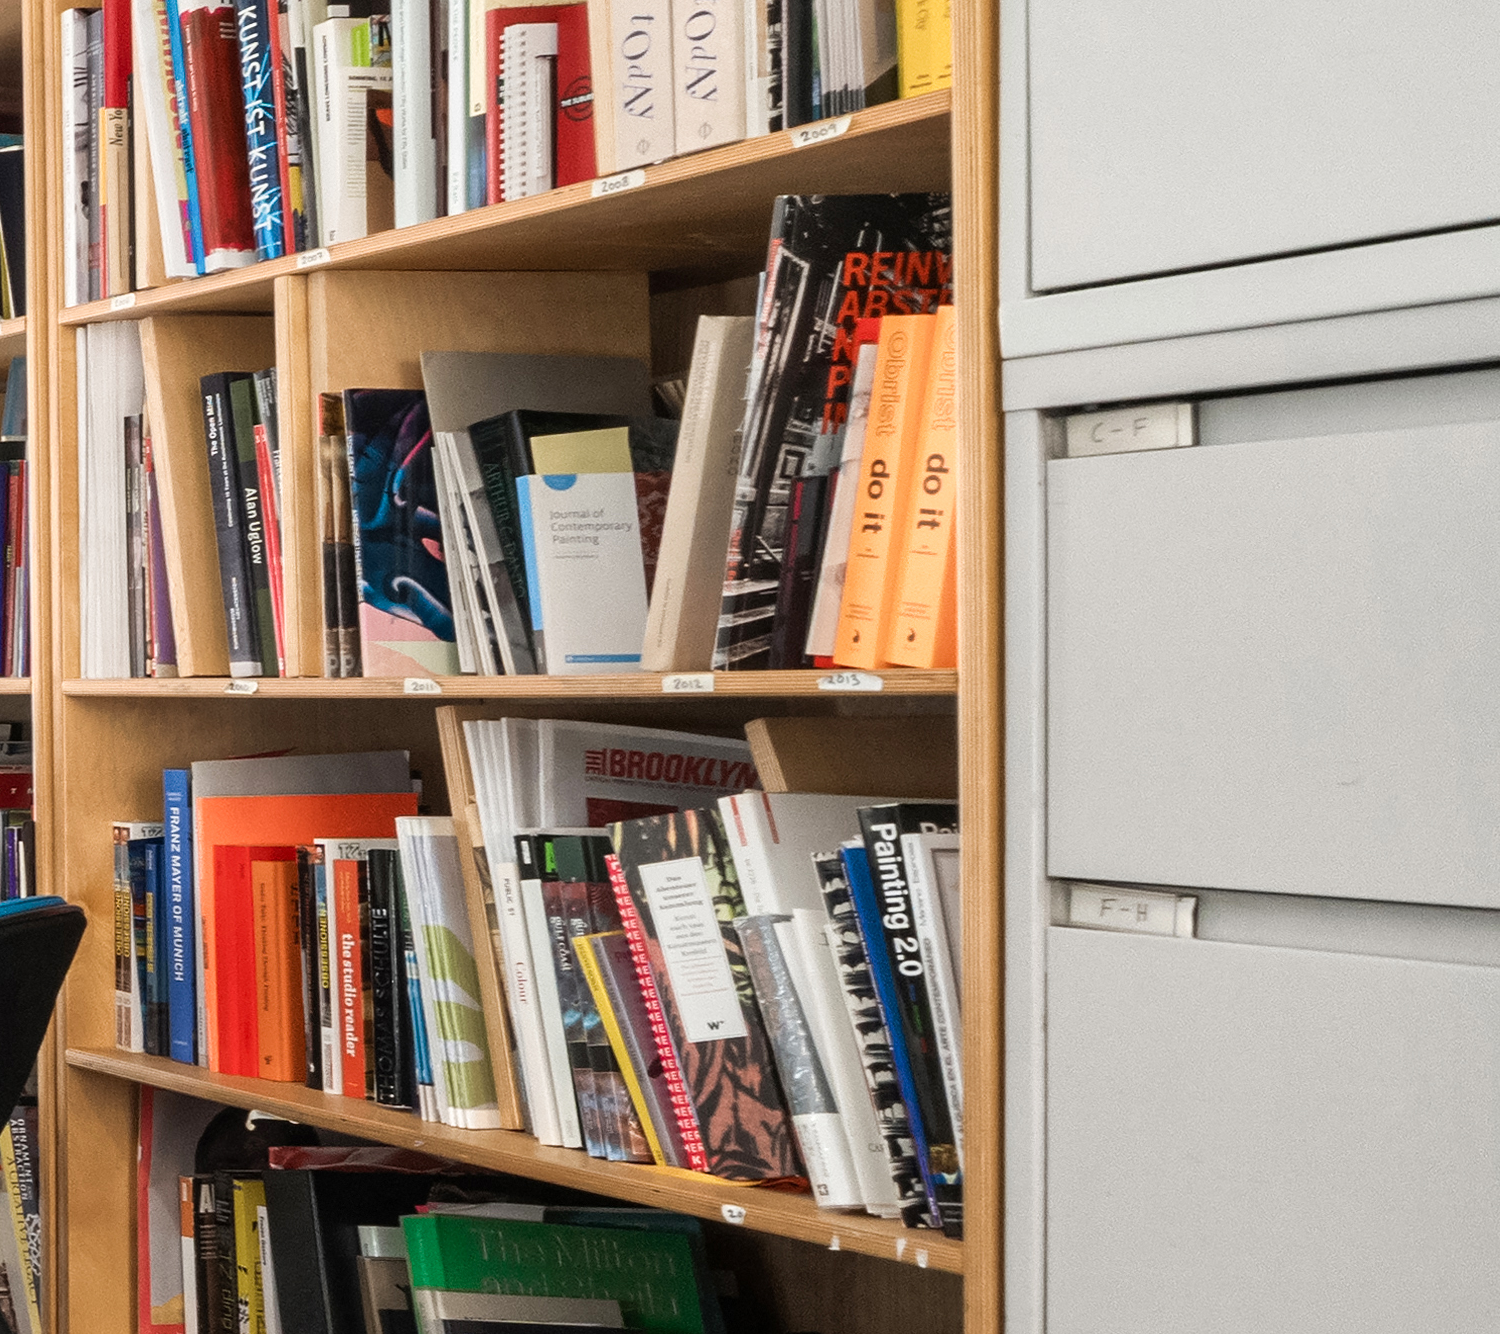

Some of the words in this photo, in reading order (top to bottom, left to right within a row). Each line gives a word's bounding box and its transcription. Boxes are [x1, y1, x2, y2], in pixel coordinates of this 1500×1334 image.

[237, 5, 263, 89] KUNST
[246, 99, 265, 138] IST
[248, 147, 274, 233] KUNST
[207, 395, 217, 415] Mind
[208, 415, 218, 439] Open
[867, 459, 891, 501] do
[923, 453, 950, 496] do
[244, 487, 258, 523] Alan
[549, 507, 590, 522] Journal
[861, 511, 886, 535] it
[916, 508, 943, 531] it
[248, 525, 264, 566] Uglow
[550, 520, 633, 535] Contemporary
[551, 533, 600, 547] Painting
[169, 806, 180, 852] FRANZ
[171, 854, 182, 897] MAYER
[172, 899, 183, 917] OF
[868, 822, 902, 932] Painting
[893, 936, 922, 978] 2.0
[173, 919, 185, 983] MUNICH
[342, 932, 352, 956] the
[372, 907, 393, 1005] SCHULTE
[343, 958, 355, 1005] studio
[345, 1005, 358, 1057] reader
[378, 1009, 397, 1102] THOMAS
